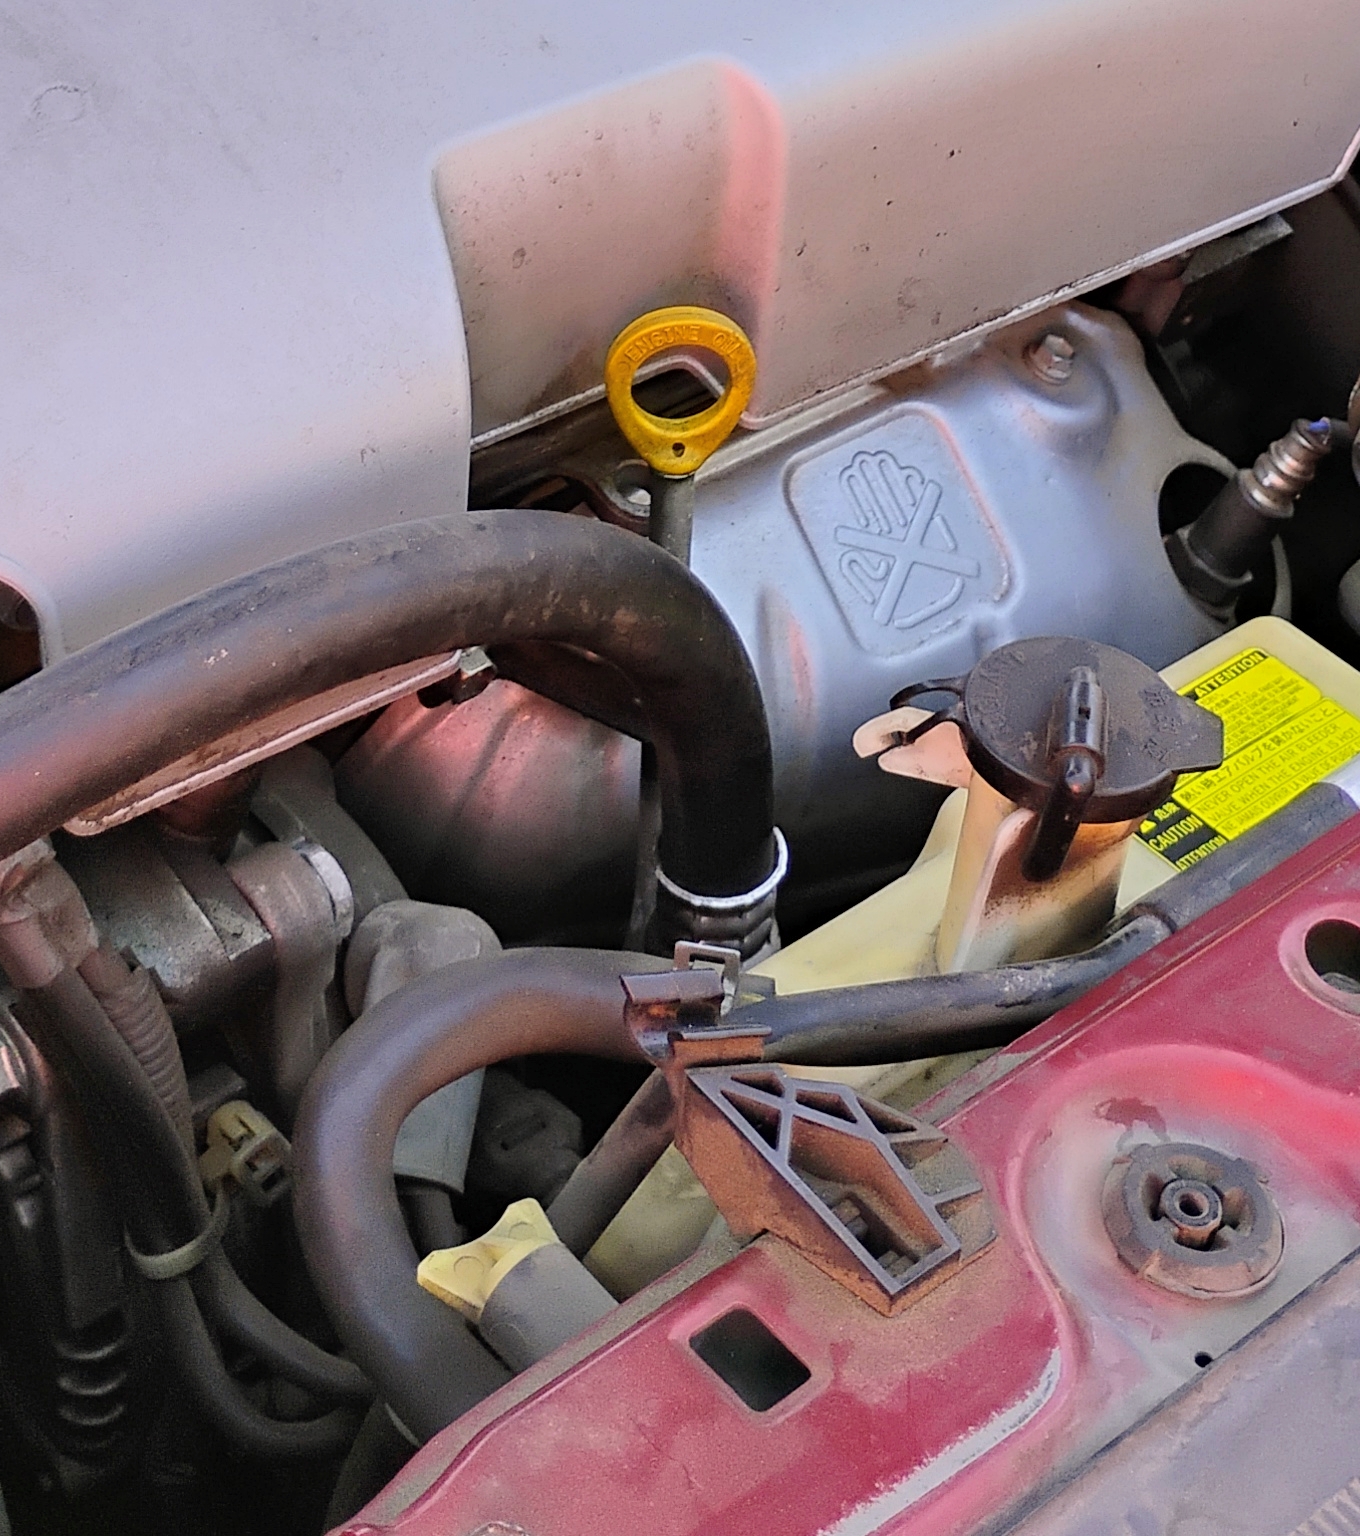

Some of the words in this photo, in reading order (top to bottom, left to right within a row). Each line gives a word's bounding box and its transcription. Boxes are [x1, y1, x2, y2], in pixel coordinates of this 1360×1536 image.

[623, 325, 702, 362] ENGINE
[1193, 651, 1264, 698] ATTENTION
[1196, 789, 1231, 813] NEVER
[1229, 772, 1260, 793] OPEN
[1256, 759, 1281, 774] THE
[1278, 748, 1298, 763] AIR
[1295, 722, 1340, 751] BLEEDER
[1207, 801, 1240, 822] VALVE
[1237, 781, 1271, 804] WHEN
[1267, 768, 1292, 785] THE
[1288, 746, 1328, 772] ENGINE
[1325, 739, 1339, 749] IS
[1149, 813, 1203, 850] CAUTION
[1221, 820, 1238, 832] NE
[1234, 804, 1263, 825] JAMAIS
[1175, 834, 1227, 870] ATTENTION
